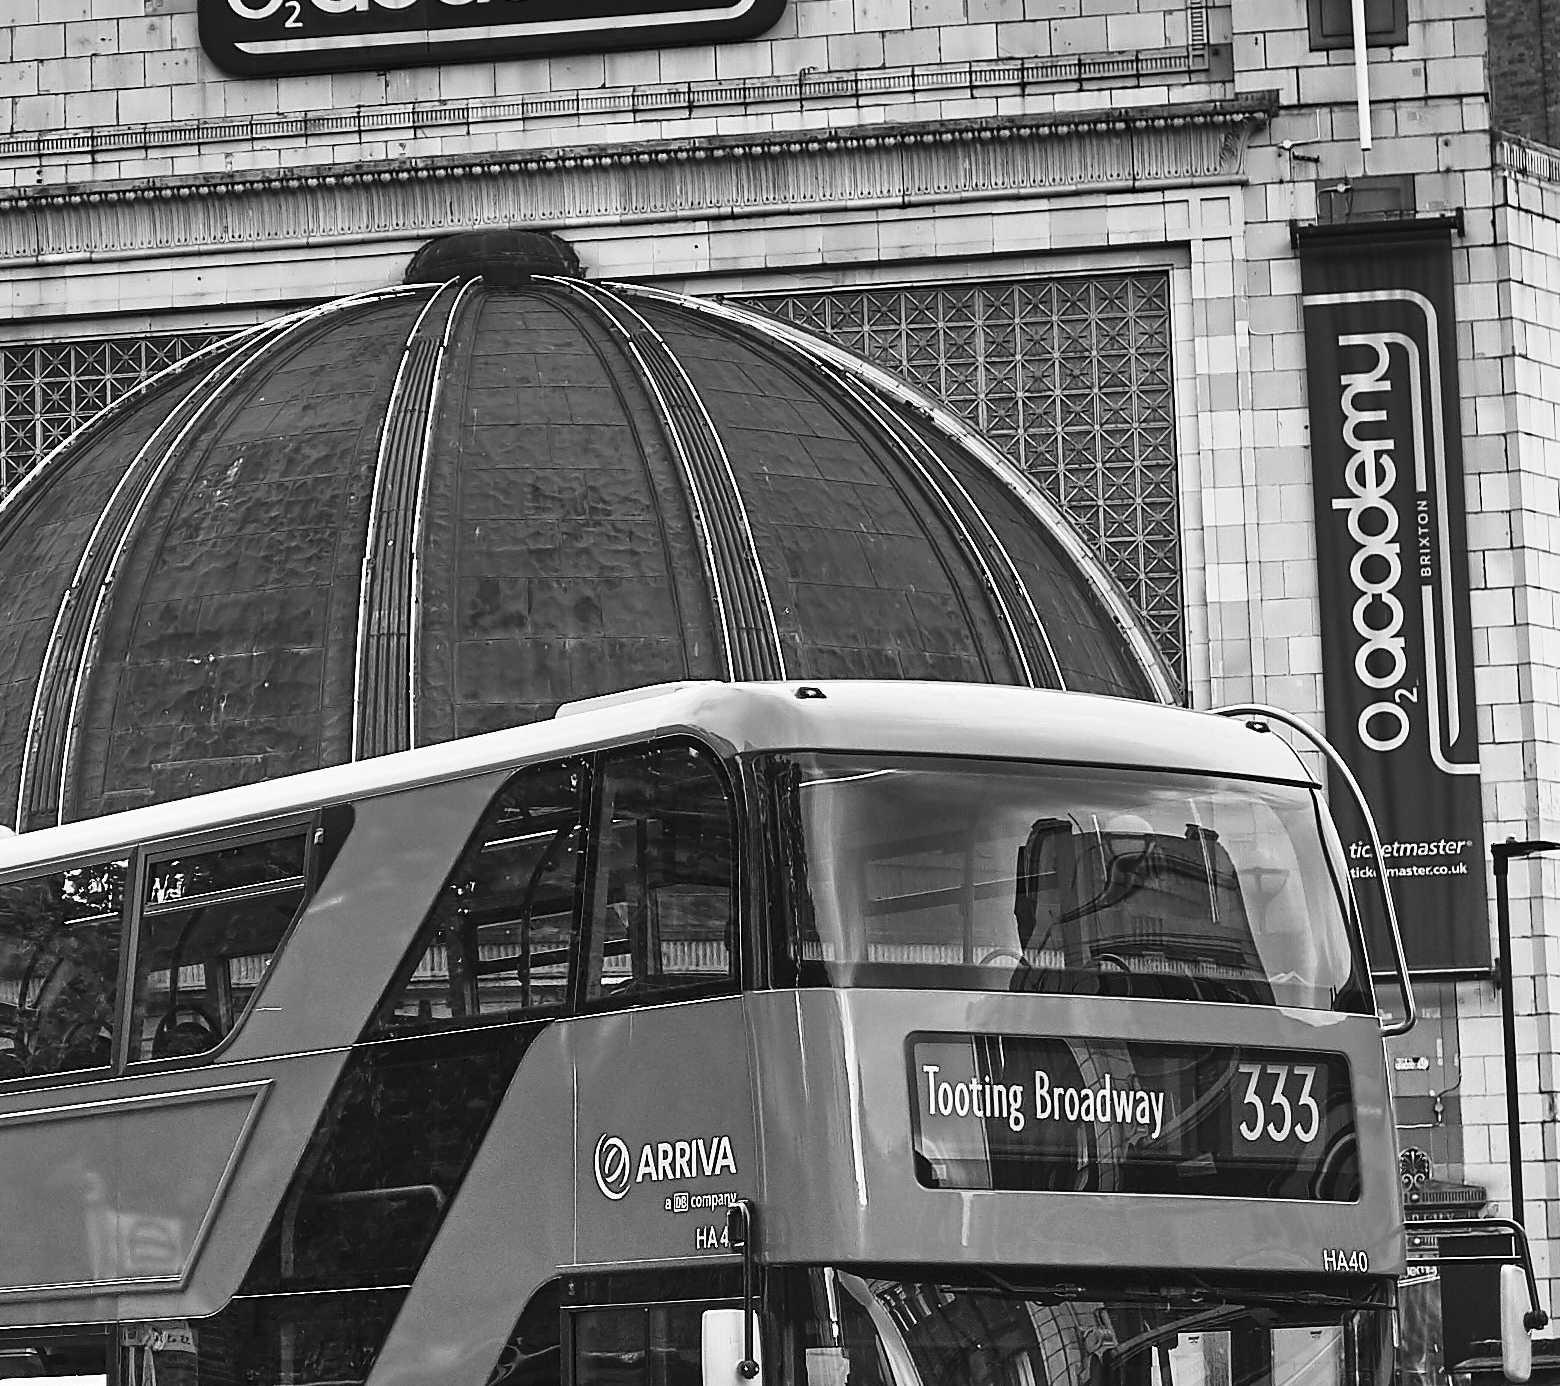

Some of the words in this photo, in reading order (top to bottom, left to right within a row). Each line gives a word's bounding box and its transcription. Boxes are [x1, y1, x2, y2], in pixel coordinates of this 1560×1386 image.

[1418, 499, 1431, 579] BRIXTON
[1349, 839, 1466, 859] ticetmaster
[923, 1064, 1025, 1131] Tooting
[1034, 1070, 1165, 1140] Broadway
[1237, 1063, 1320, 1143] 333
[636, 1136, 738, 1183] ARRIVA
[664, 1197, 672, 1210] a
[690, 1192, 738, 1212] company
[1322, 1249, 1368, 1274] HA40
